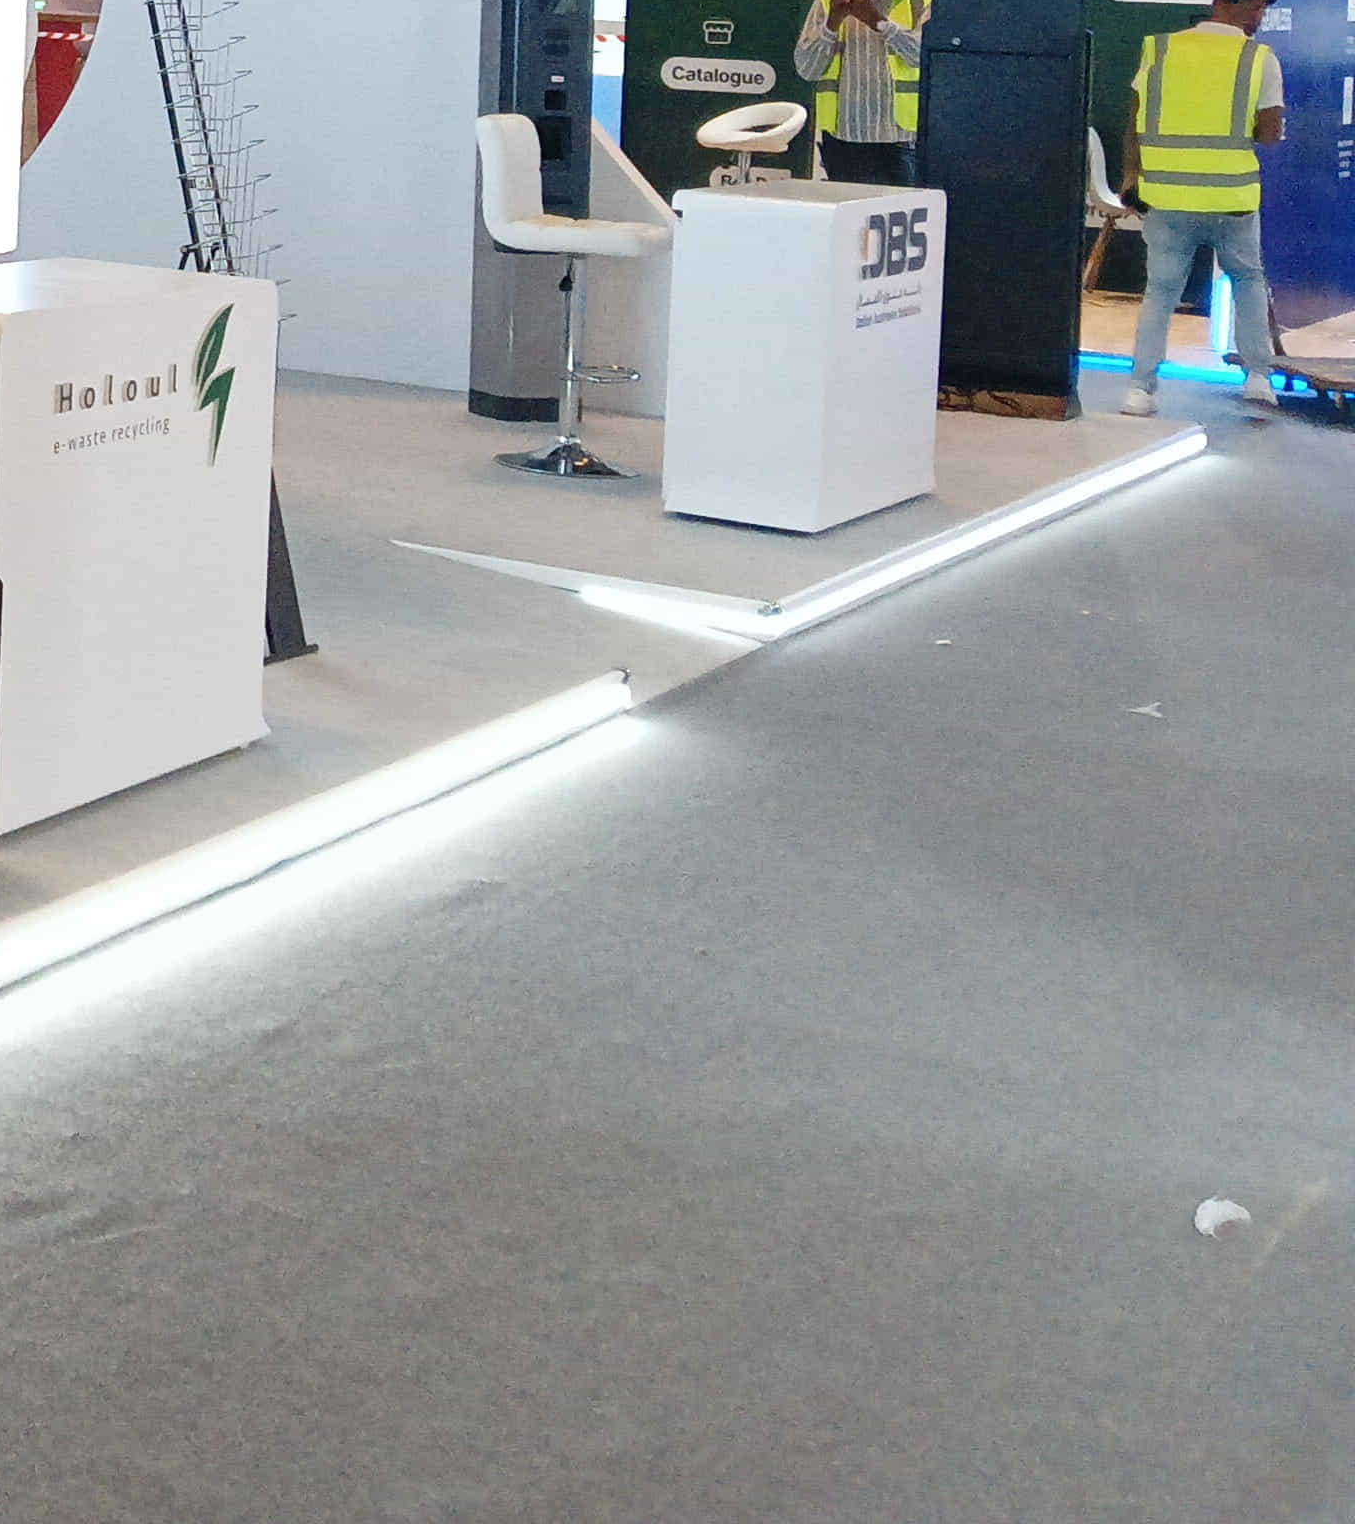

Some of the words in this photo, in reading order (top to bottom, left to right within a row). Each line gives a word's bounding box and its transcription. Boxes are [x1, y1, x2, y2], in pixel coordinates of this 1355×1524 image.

[672, 66, 765, 88] Catalogue
[859, 208, 928, 280] DBS
[54, 363, 178, 414] Holoul
[53, 428, 107, 454] e-waste
[111, 417, 170, 442] recycling
